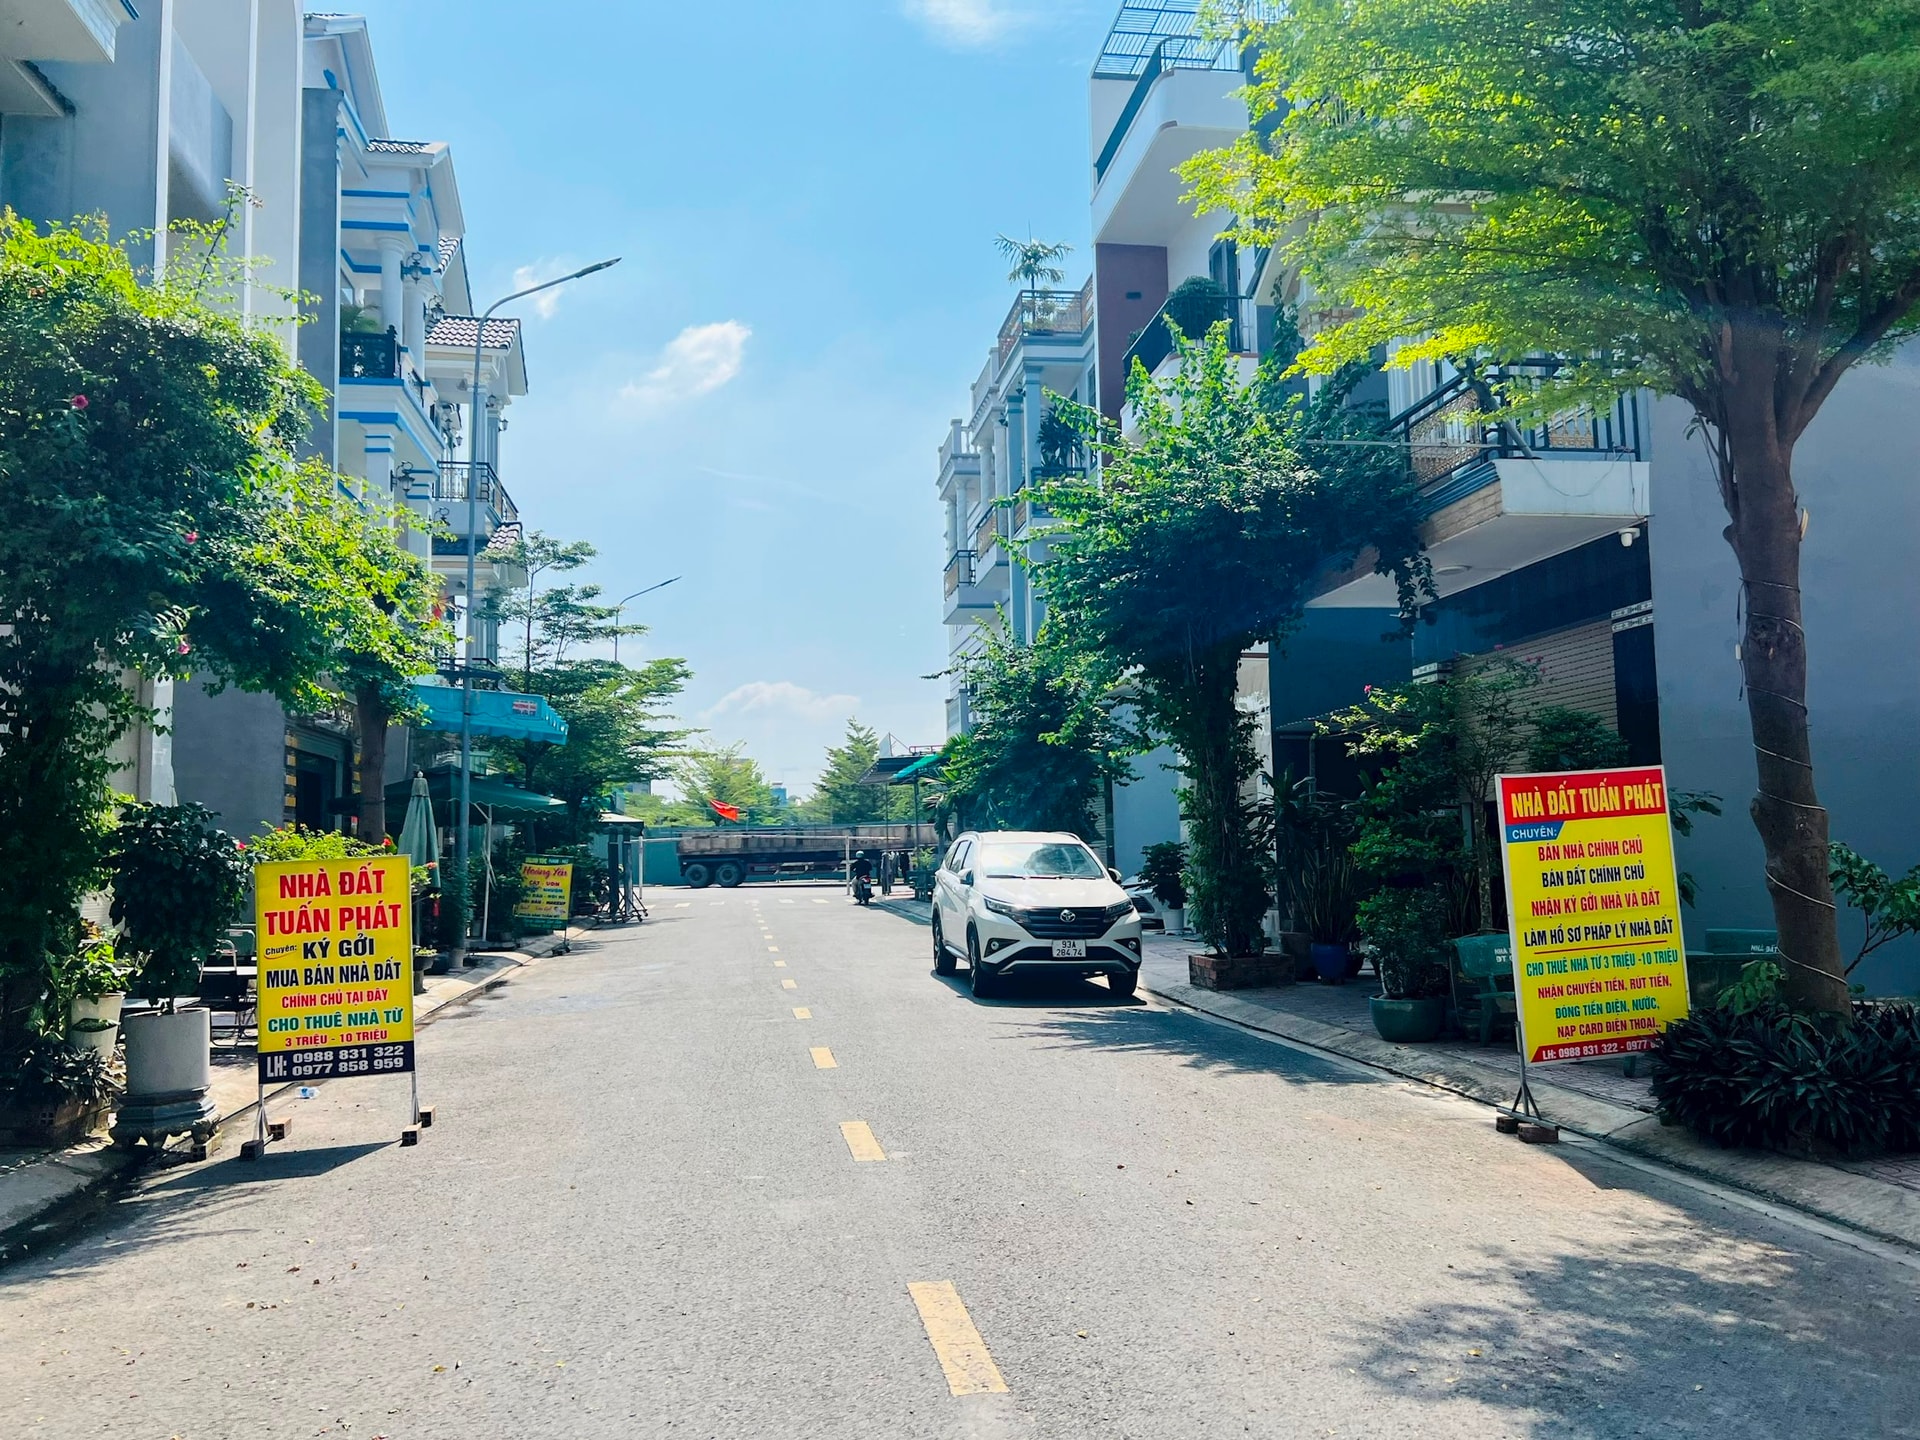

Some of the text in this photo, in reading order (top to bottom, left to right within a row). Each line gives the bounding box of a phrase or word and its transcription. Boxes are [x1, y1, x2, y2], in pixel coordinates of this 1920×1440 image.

[1511, 778, 1661, 817] NHÀ ĐẤT TUẤN PHÁT
[1512, 827, 1557, 839] CHUYÊN:
[1538, 834, 1642, 861] BÁN NHÀ CHÍNH CHỦ
[280, 862, 385, 898] NHÀ ĐẤT
[1542, 860, 1644, 887] BÁN ĐẤT CHÍNH CHỦ
[1532, 897, 1561, 918] NHẬN
[1564, 895, 1576, 913] KÝ
[1601, 891, 1622, 909] NHÀ
[1625, 890, 1638, 907] VÀ
[1641, 886, 1660, 906] ĐẤT
[265, 900, 401, 935] TUẤN PHÁT
[1524, 928, 1546, 947] LÀM
[1568, 925, 1580, 943] SƠ
[1585, 922, 1611, 941] PHÁP
[1615, 920, 1626, 938] LÝ
[1630, 918, 1651, 937] NHÀ
[1654, 914, 1673, 935] ĐẤT
[265, 945, 297, 956] Chuyên:
[303, 933, 374, 959] KÝ GỞI
[1062, 940, 1076, 948] 93A
[266, 956, 401, 988] MUA BÁN NHÀ ĐẤT
[1526, 962, 1543, 977] CHO
[1547, 957, 1568, 974] THUÊ
[1571, 955, 1588, 972] NHÀ
[1604, 955, 1609, 968] 3
[1612, 951, 1635, 970] TRIỆU
[1654, 947, 1678, 966] TRIỆU
[282, 988, 388, 1008] CHÍNH CHỦ TẠI ĐÂY
[1538, 984, 1563, 999] NHẬN
[1630, 976, 1646, 989] RÚT
[268, 1007, 403, 1032] CHO THUÊ NHÀ TỪ
[1555, 1004, 1580, 1019] ĐÓNG
[286, 1038, 291, 1047] 3
[296, 1034, 327, 1046] TRIỆU
[340, 1033, 352, 1042] 10
[356, 1029, 387, 1042] TRIỆU
[1558, 1026, 1576, 1040] NẠP
[1579, 1023, 1602, 1035] CARD
[1606, 1018, 1627, 1034] ĐIỆN
[293, 1046, 404, 1063] 0988 831 322
[1542, 1050, 1556, 1060] LH:
[1559, 1047, 1580, 1058] 0988
[1583, 1045, 1599, 1055] 831
[1601, 1043, 1617, 1053] 322
[1627, 1040, 1647, 1051] 0977
[267, 1056, 287, 1077] LH:
[293, 1058, 403, 1076] 0977 858 959
